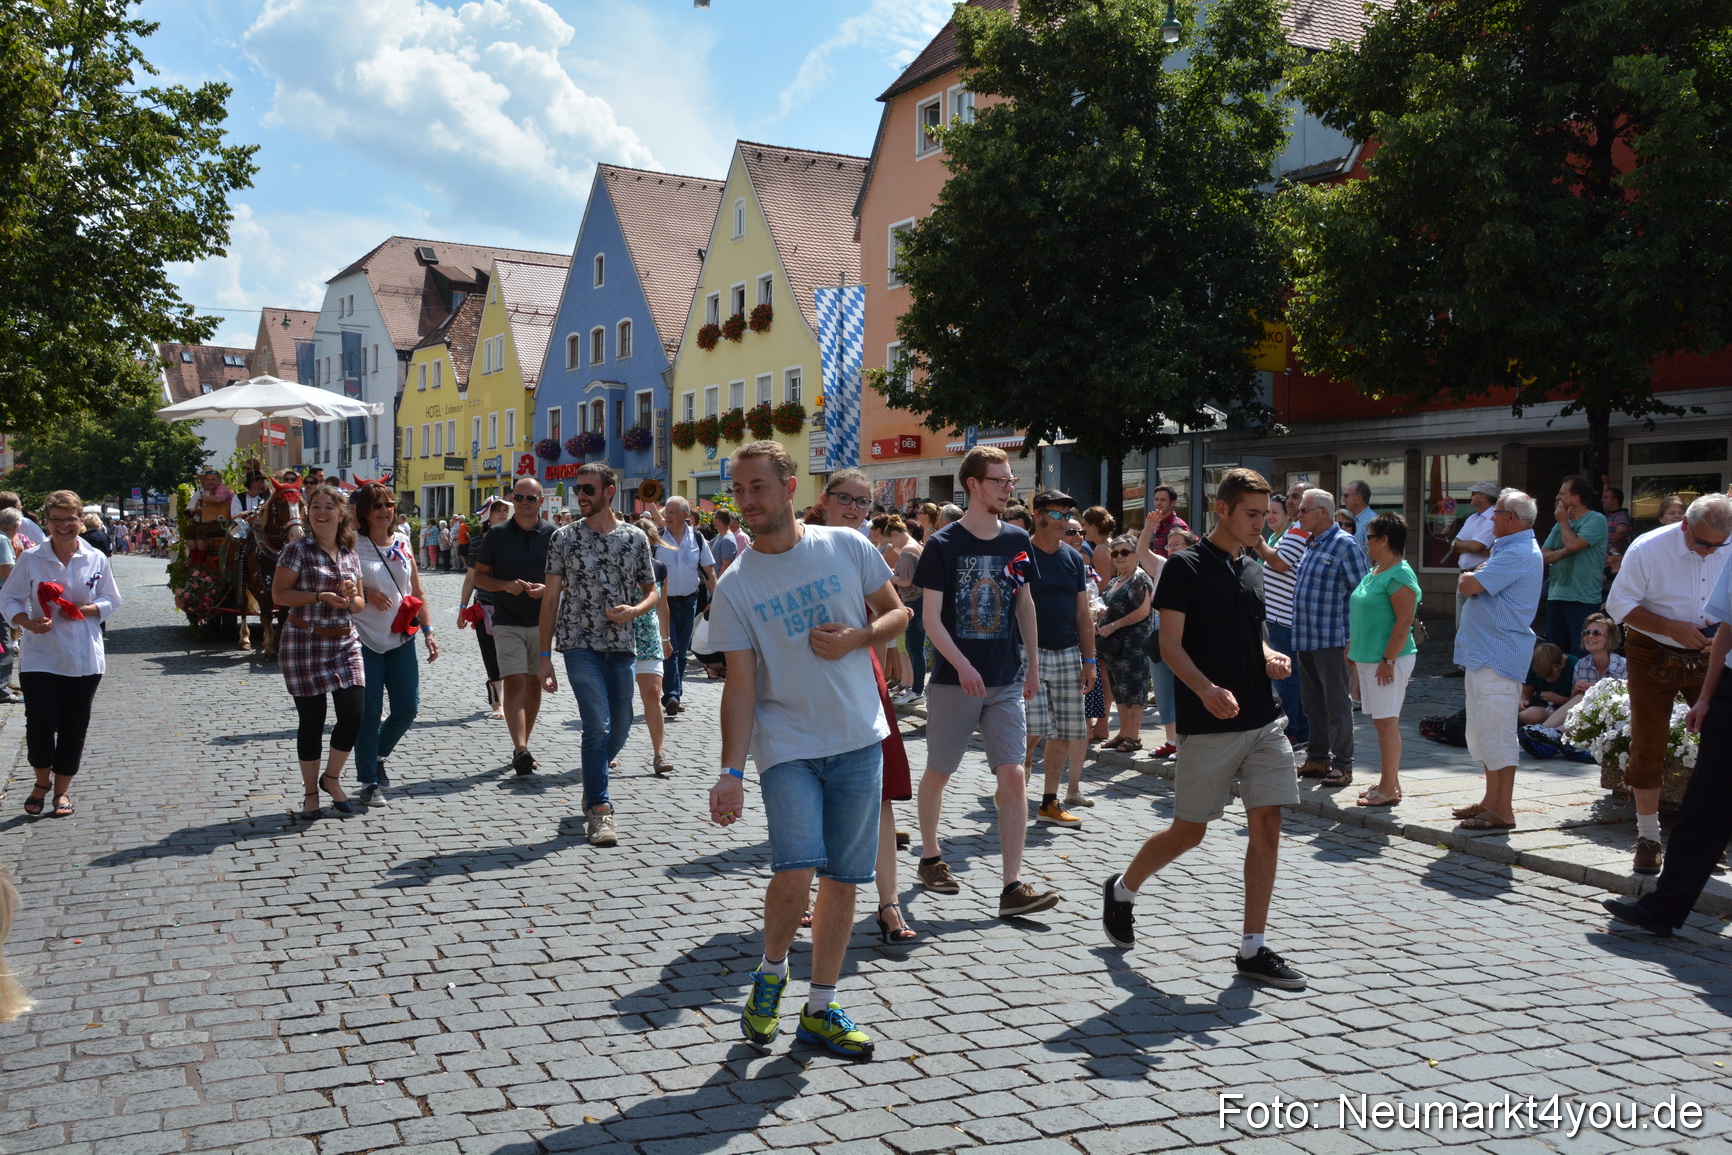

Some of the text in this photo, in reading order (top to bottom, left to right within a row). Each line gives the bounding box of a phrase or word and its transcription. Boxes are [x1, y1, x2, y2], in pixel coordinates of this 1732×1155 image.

[425, 404, 441, 419] HOTEL
[967, 426, 975, 446] P
[872, 443, 882, 455] DER
[902, 438, 917, 448] DER
[815, 447, 827, 456] RIALT
[423, 471, 446, 481] Restaurant
[964, 557, 977, 569] 19
[754, 574, 842, 622] THANKS
[783, 603, 830, 636] 1972
